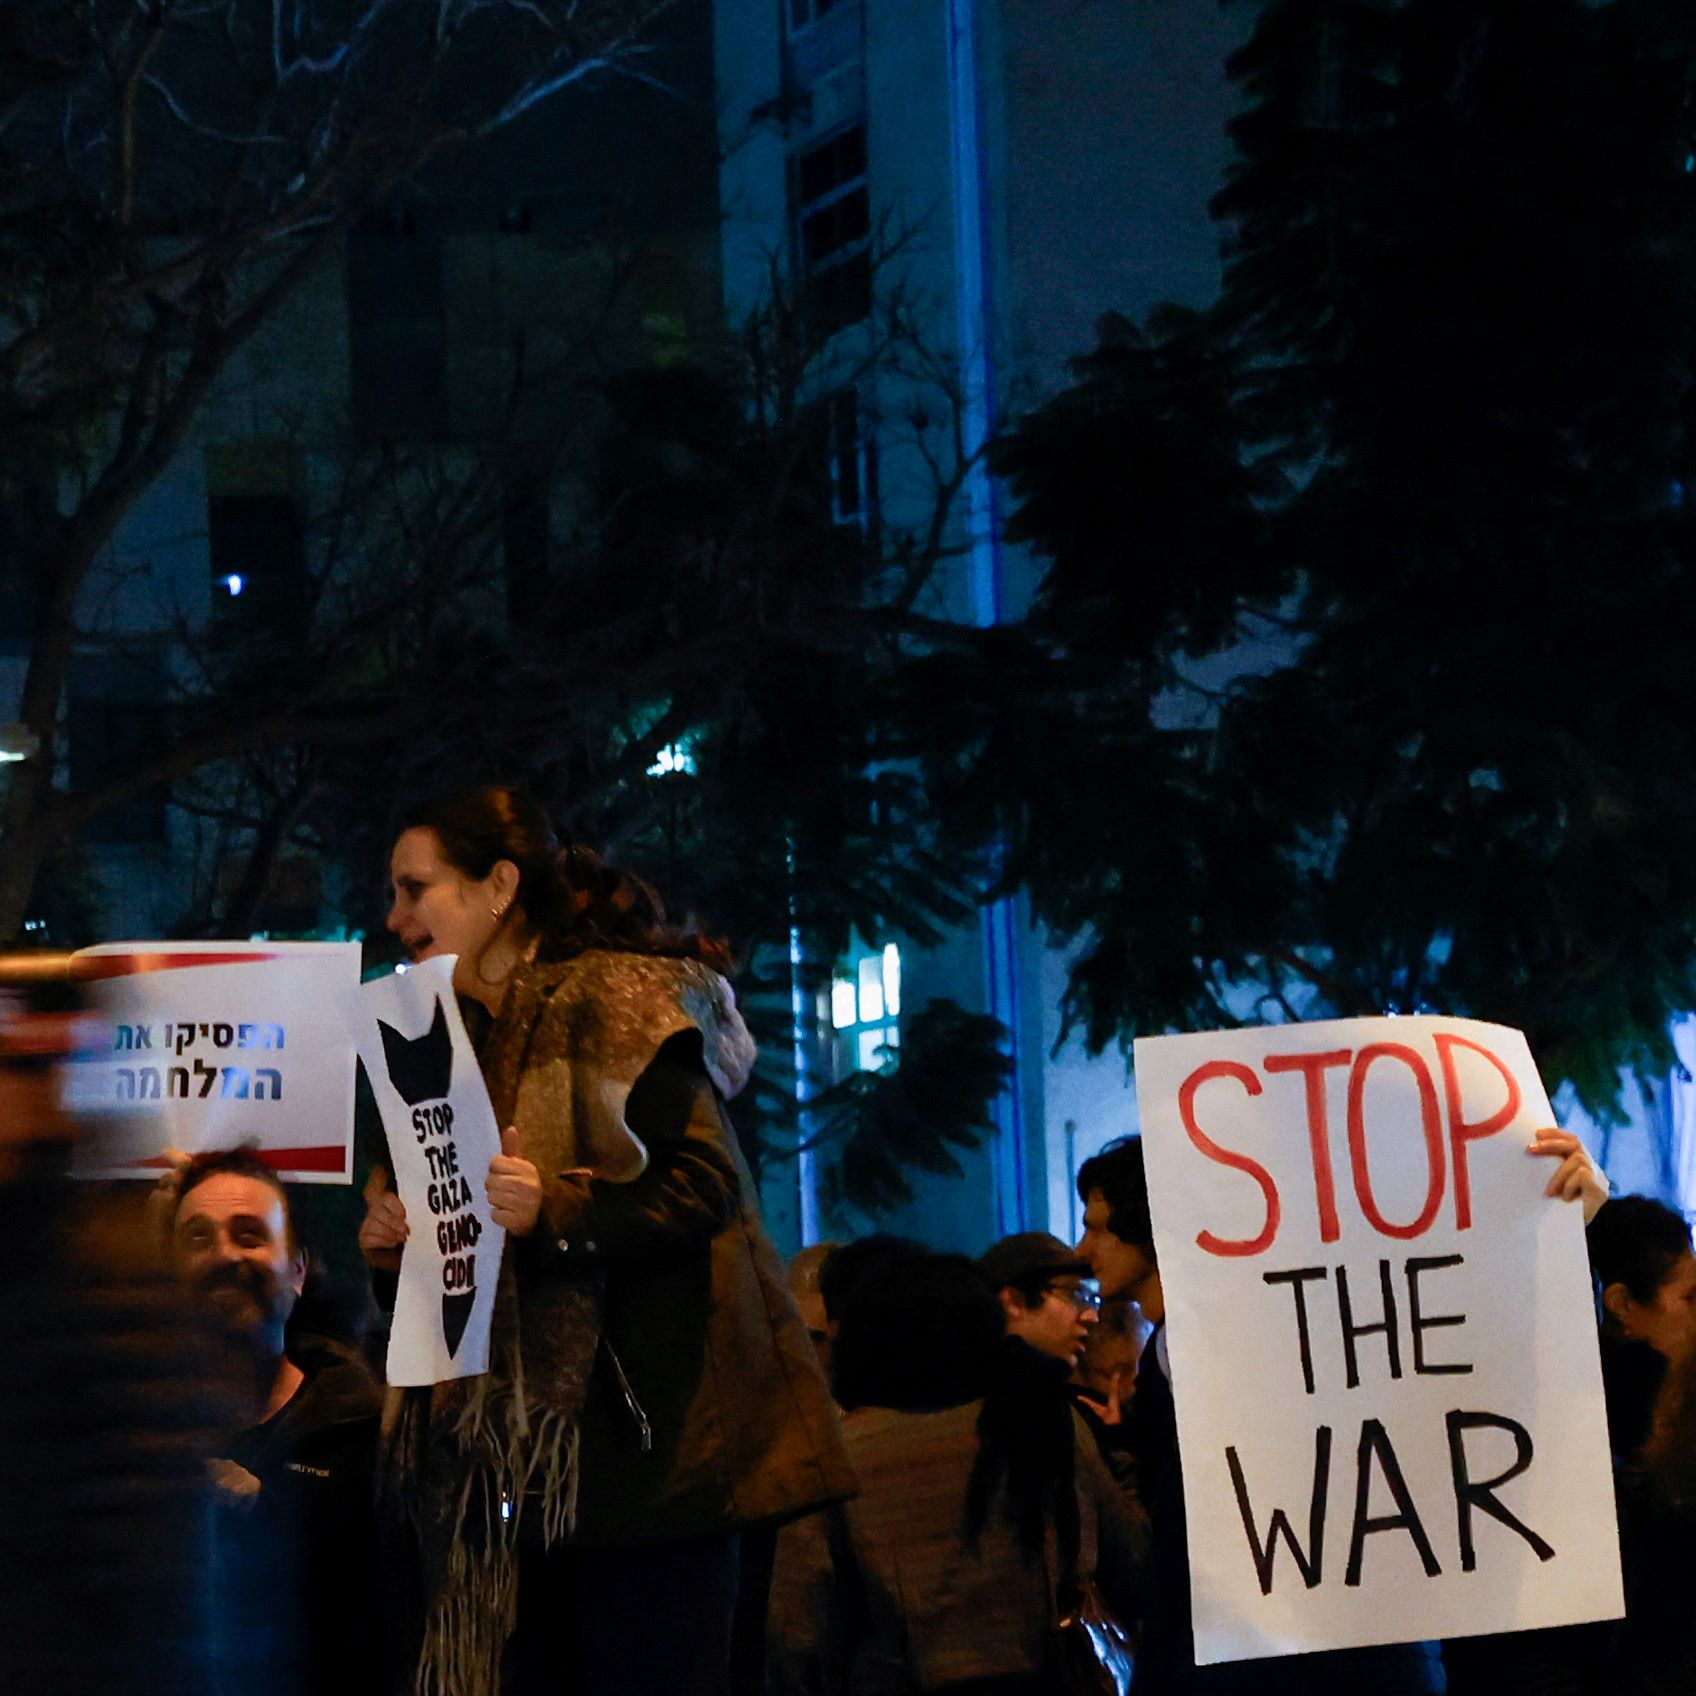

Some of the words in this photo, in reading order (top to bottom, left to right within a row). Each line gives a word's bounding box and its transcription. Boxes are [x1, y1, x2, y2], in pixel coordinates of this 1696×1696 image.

[114, 1023, 153, 1050] את
[164, 1023, 285, 1056] הפסיקו
[115, 1058, 283, 1101] המלחמה
[412, 1103, 454, 1144] STOP
[425, 1141, 459, 1180] THE
[1177, 1031, 1521, 1258] STOP
[427, 1175, 473, 1216] GAZA
[1263, 1253, 1474, 1395] THE
[1225, 1410, 1557, 1597] WAR
